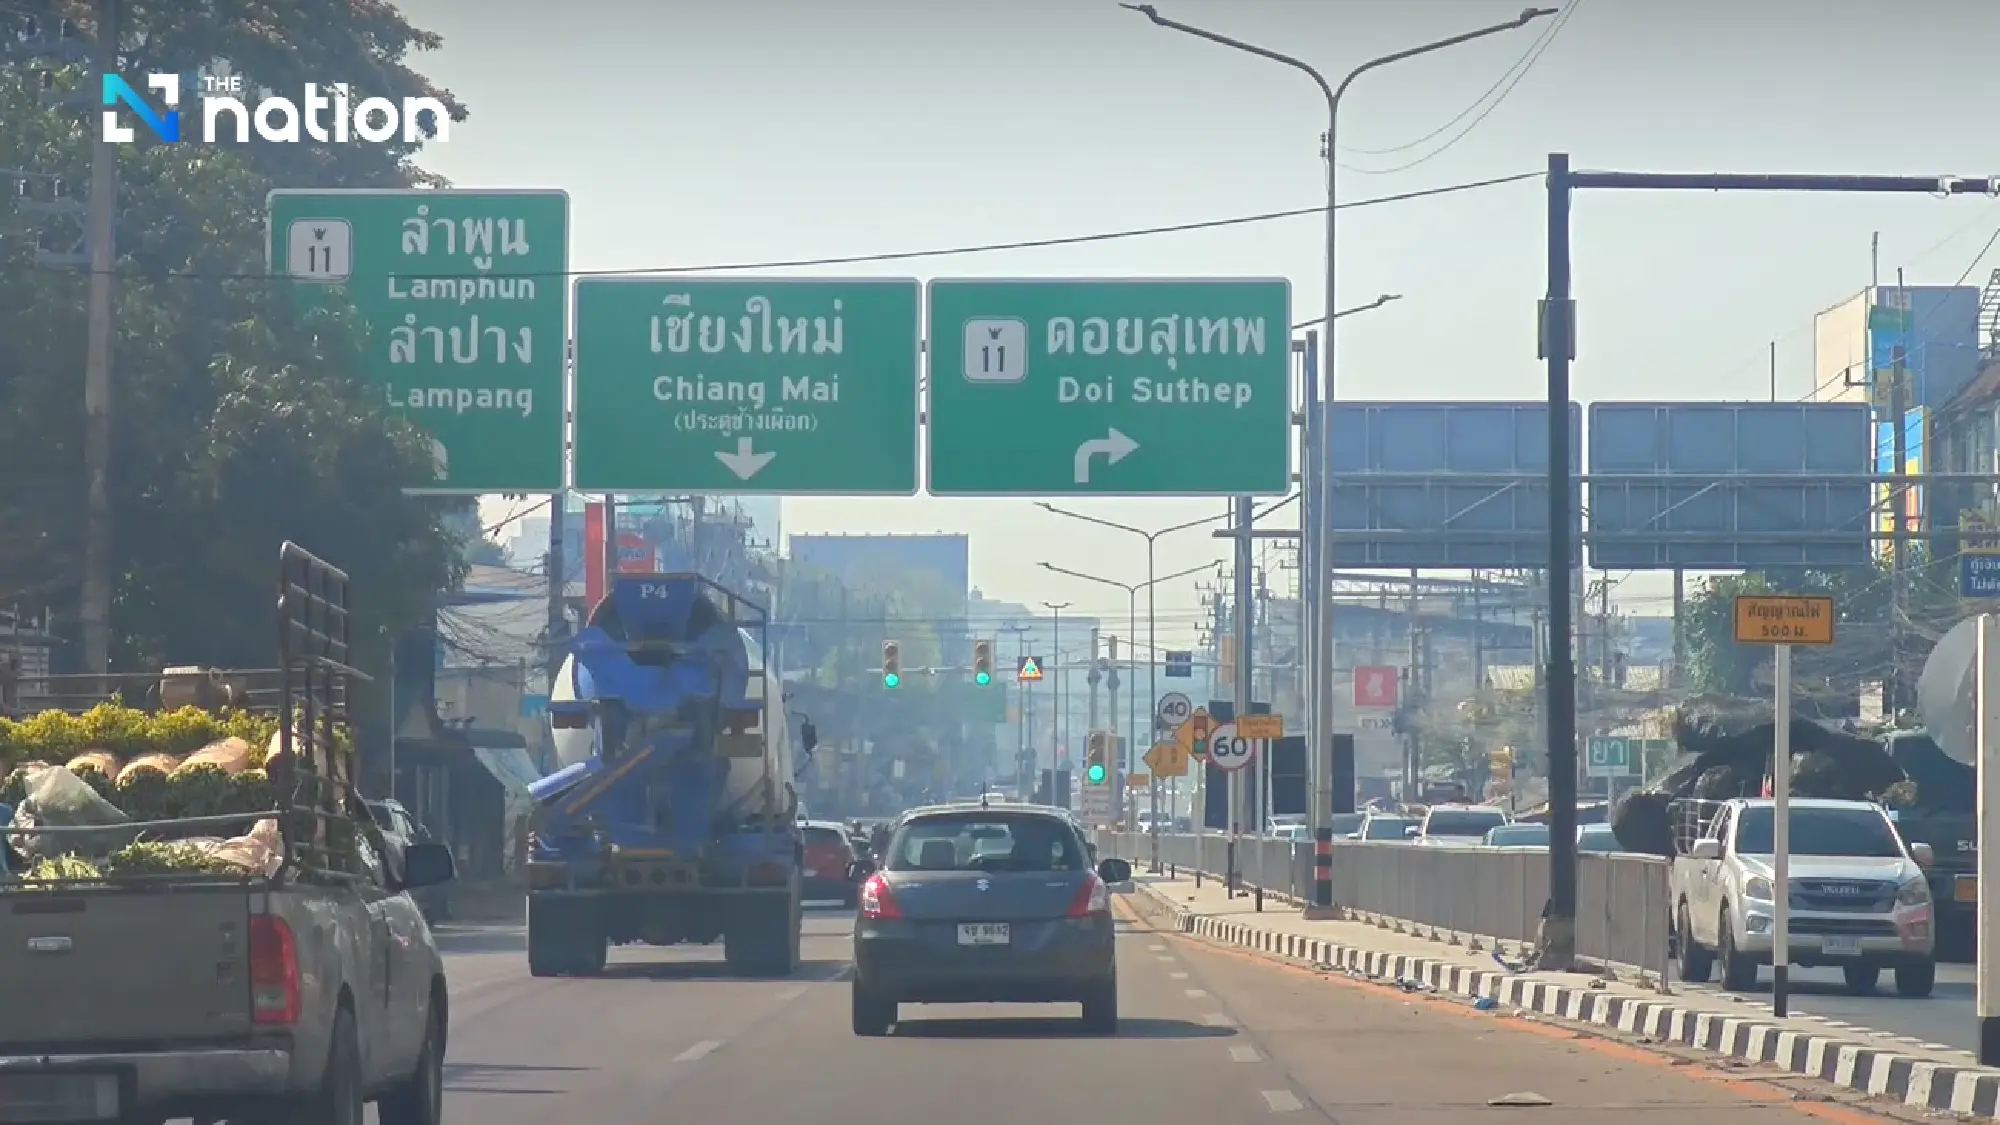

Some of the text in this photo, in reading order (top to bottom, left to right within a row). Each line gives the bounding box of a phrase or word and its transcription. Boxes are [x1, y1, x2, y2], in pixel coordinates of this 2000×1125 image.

[401, 204, 531, 270] ลำพูน
[307, 245, 332, 273] 11
[387, 272, 536, 305] Lamphun
[389, 312, 533, 364] ลำปาง
[650, 292, 844, 354] เชียงใหม่
[1046, 312, 1267, 371] ดอยสุเทพ
[981, 344, 1006, 373] 11
[652, 373, 840, 410] Chiang Mai
[1057, 375, 1254, 410] Doi Suthep
[640, 583, 668, 599] P4
[1761, 624, 1790, 637] 500
[1162, 701, 1188, 717] 40
[1213, 735, 1249, 757] 60
